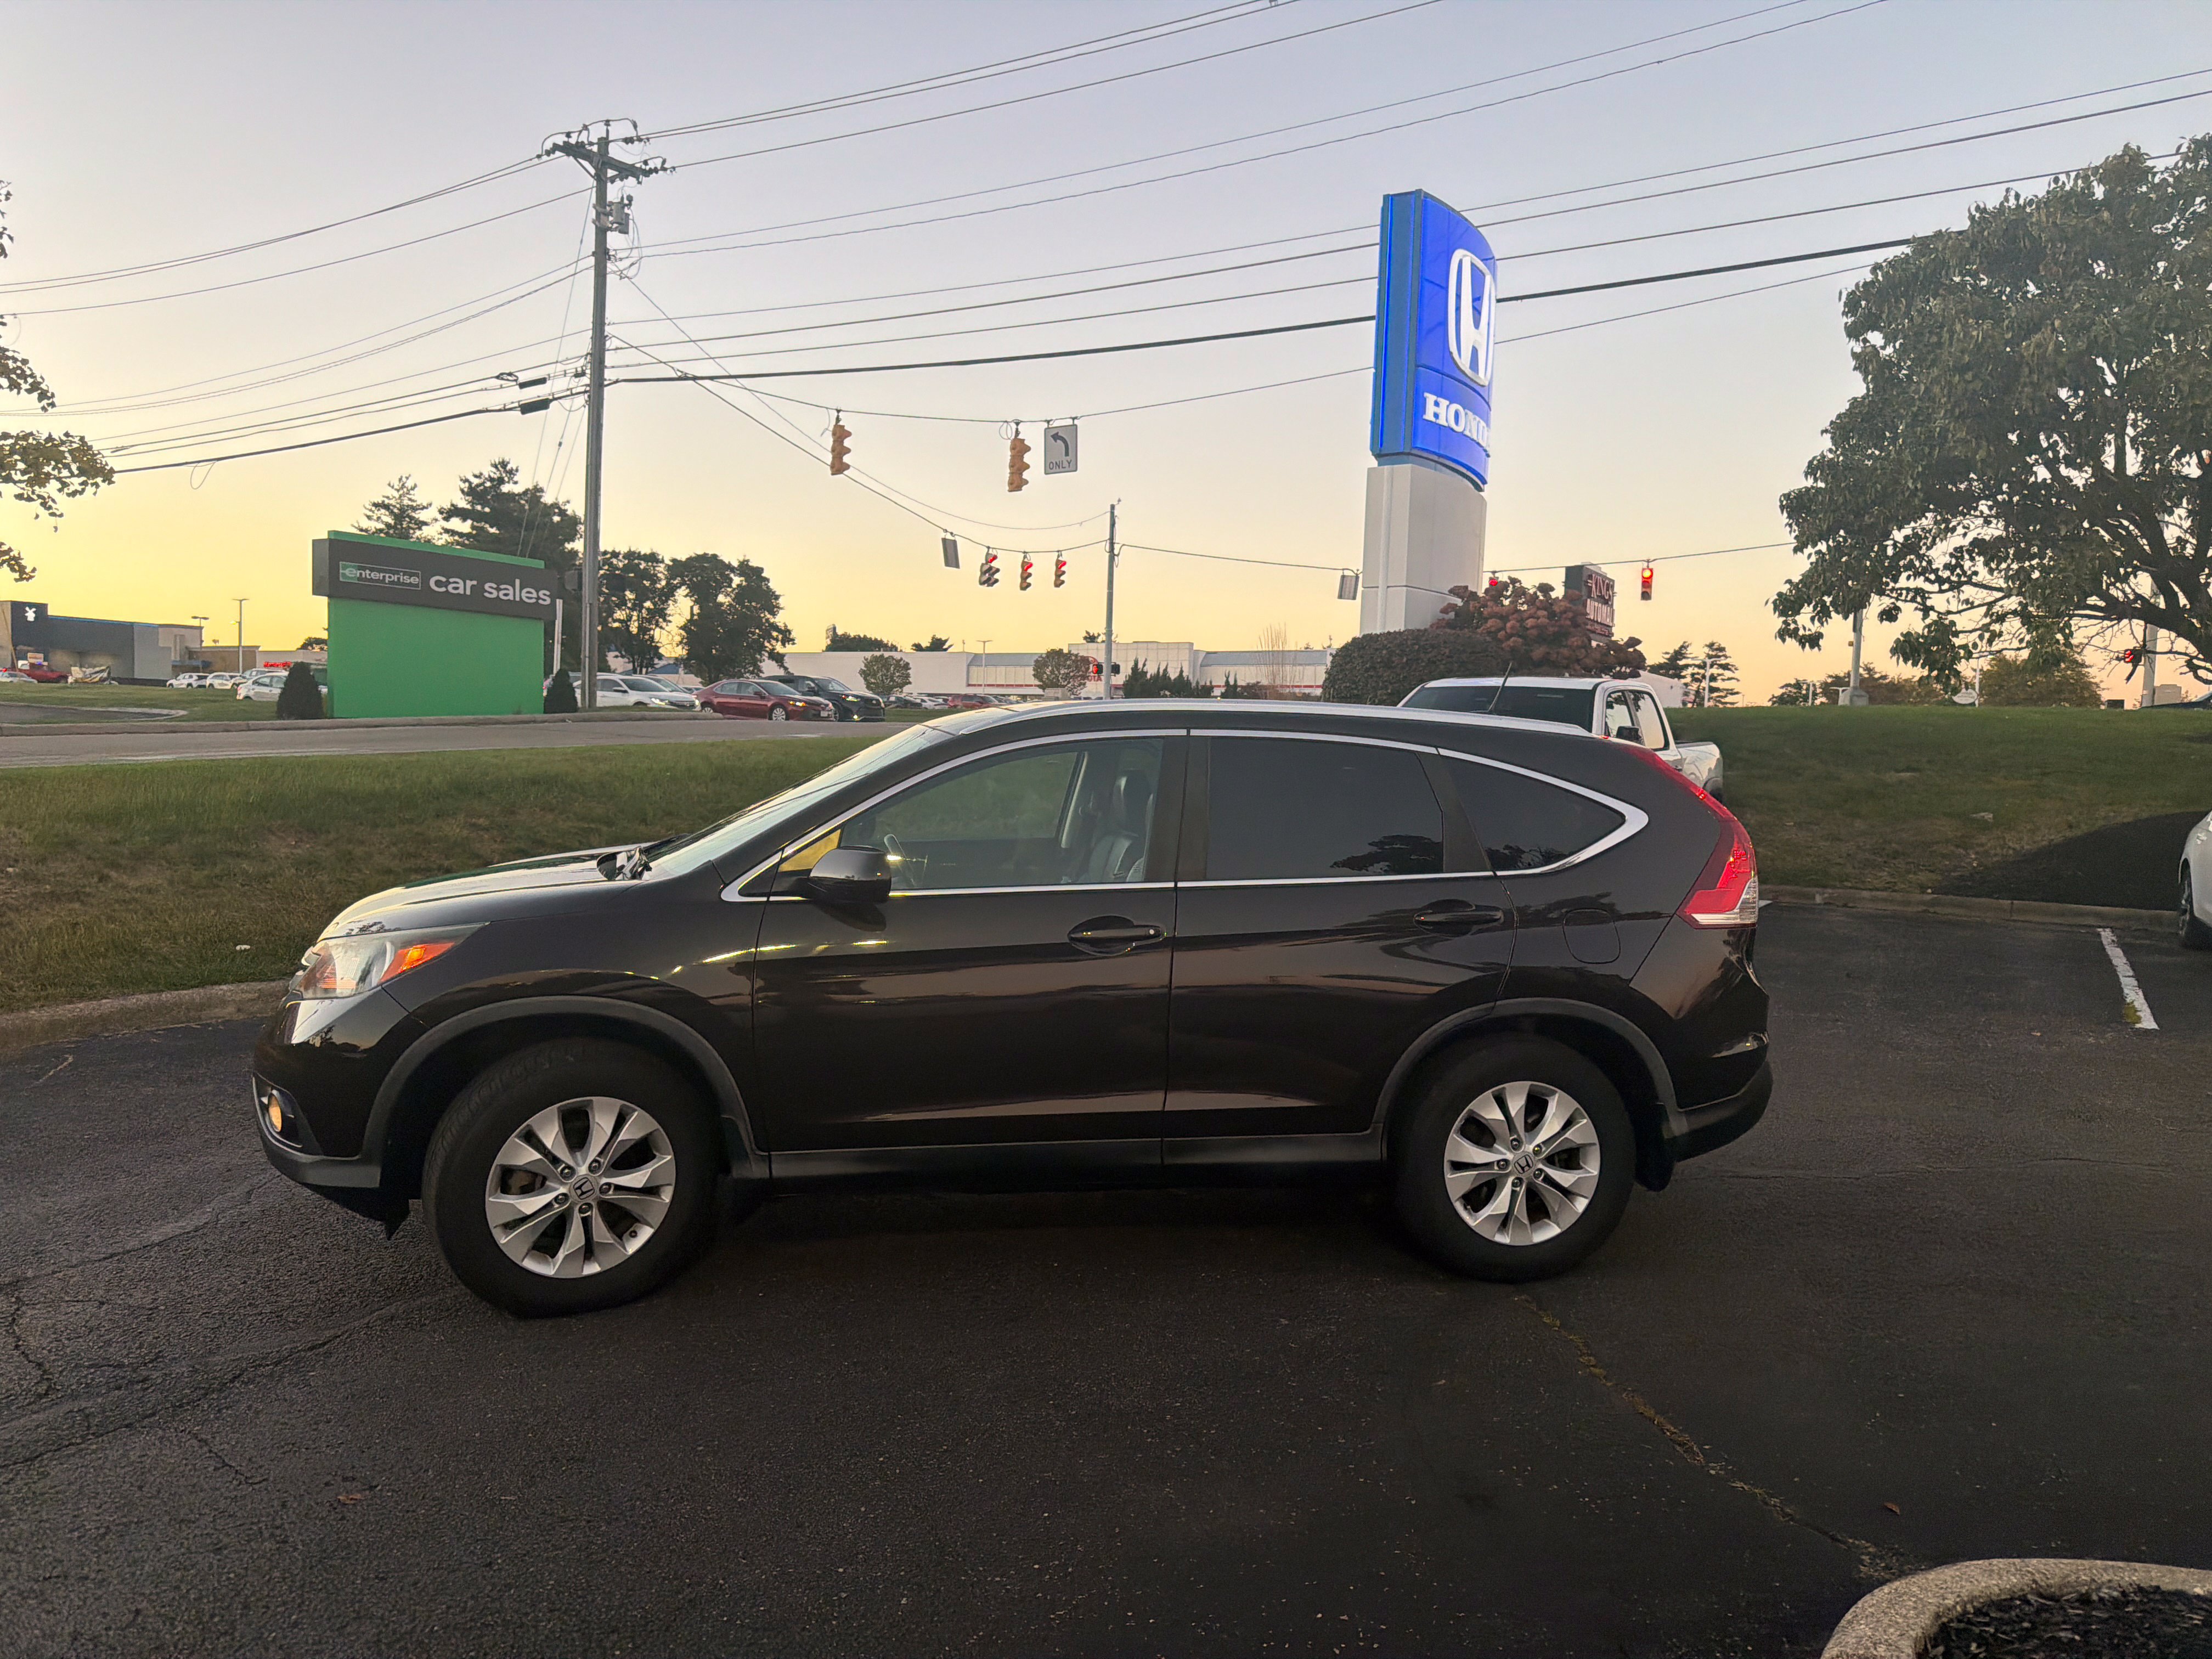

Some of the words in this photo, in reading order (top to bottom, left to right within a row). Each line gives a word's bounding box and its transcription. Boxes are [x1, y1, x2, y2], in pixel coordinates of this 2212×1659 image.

[1423, 392, 1491, 449] HOND
[1048, 459, 1072, 470] ONLY
[345, 568, 419, 584] enterprise
[429, 575, 477, 595] car
[483, 578, 551, 605] sales
